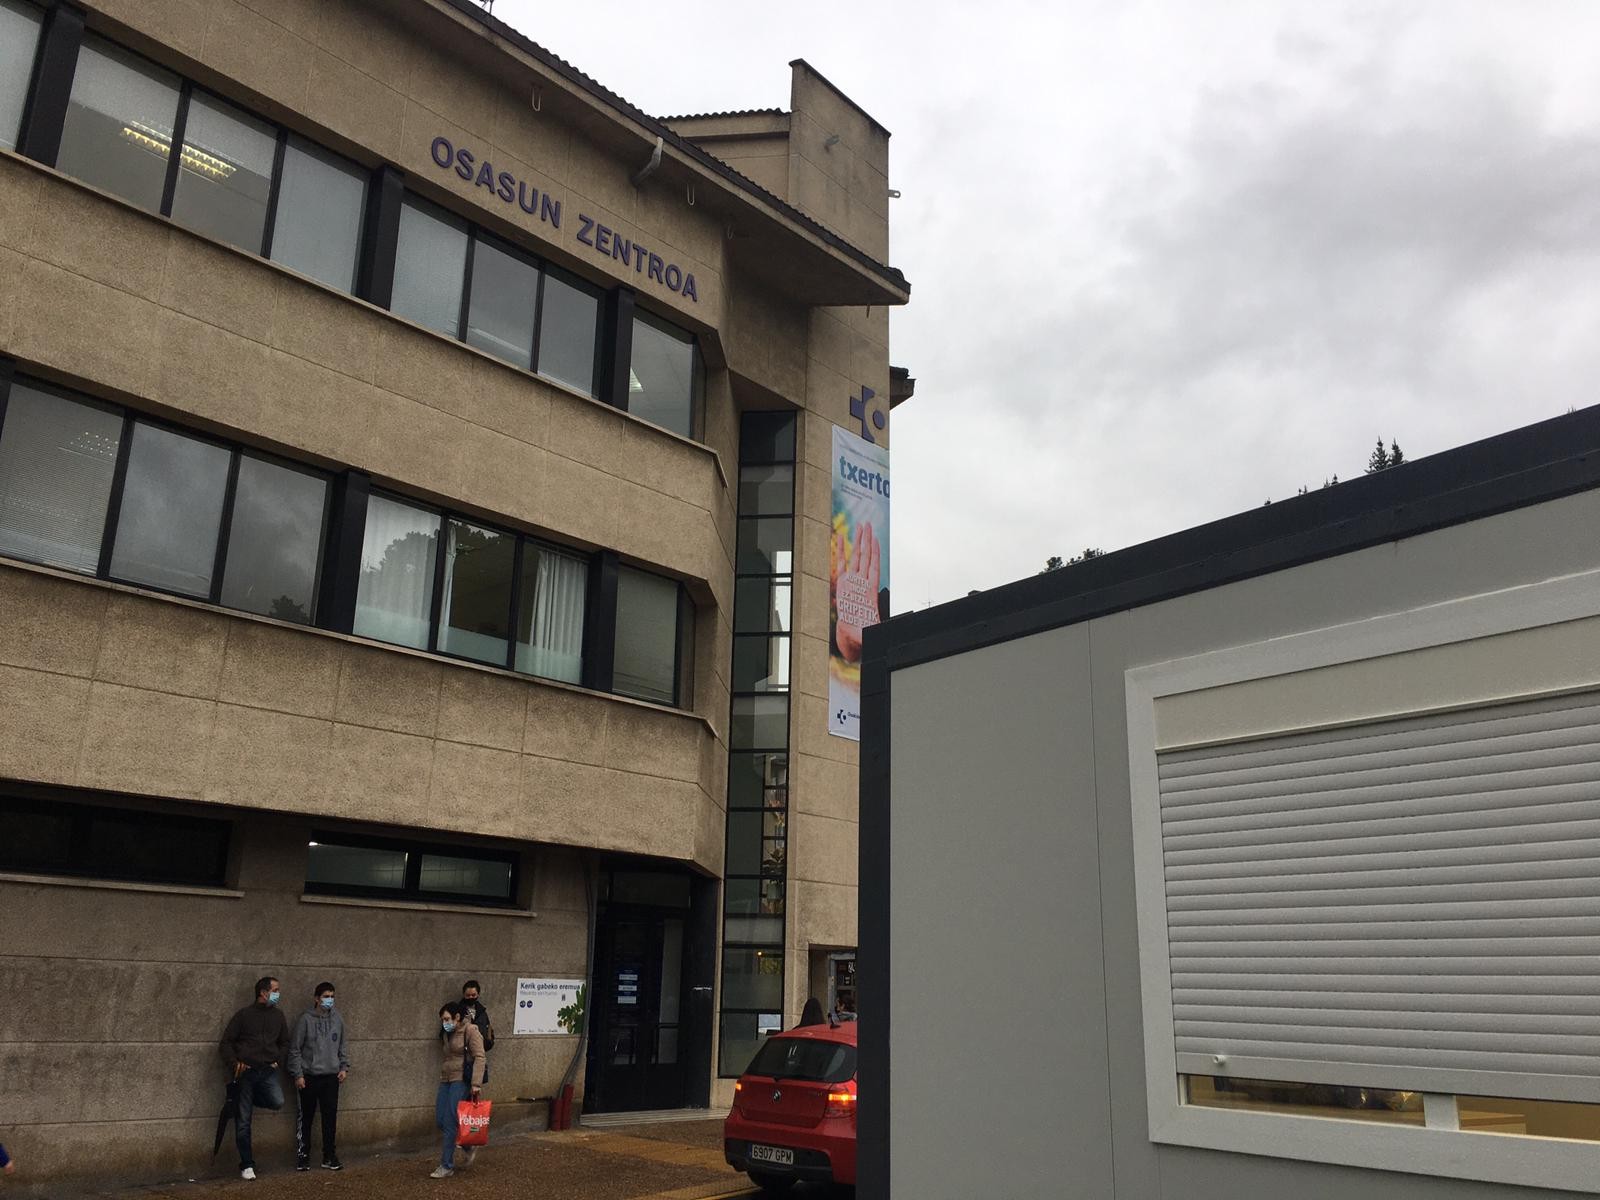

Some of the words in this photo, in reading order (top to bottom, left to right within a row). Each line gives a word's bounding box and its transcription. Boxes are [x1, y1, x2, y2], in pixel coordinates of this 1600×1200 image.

[431, 136, 561, 229] OSASUN
[576, 213, 698, 302] ZENTROA
[839, 455, 890, 498] txerto
[839, 599, 878, 622] GRIPETIK
[520, 982, 536, 990] Kerik
[537, 982, 559, 991] gabeko
[753, 1145, 773, 1160] 6907
[775, 1150, 792, 1163] GPM
